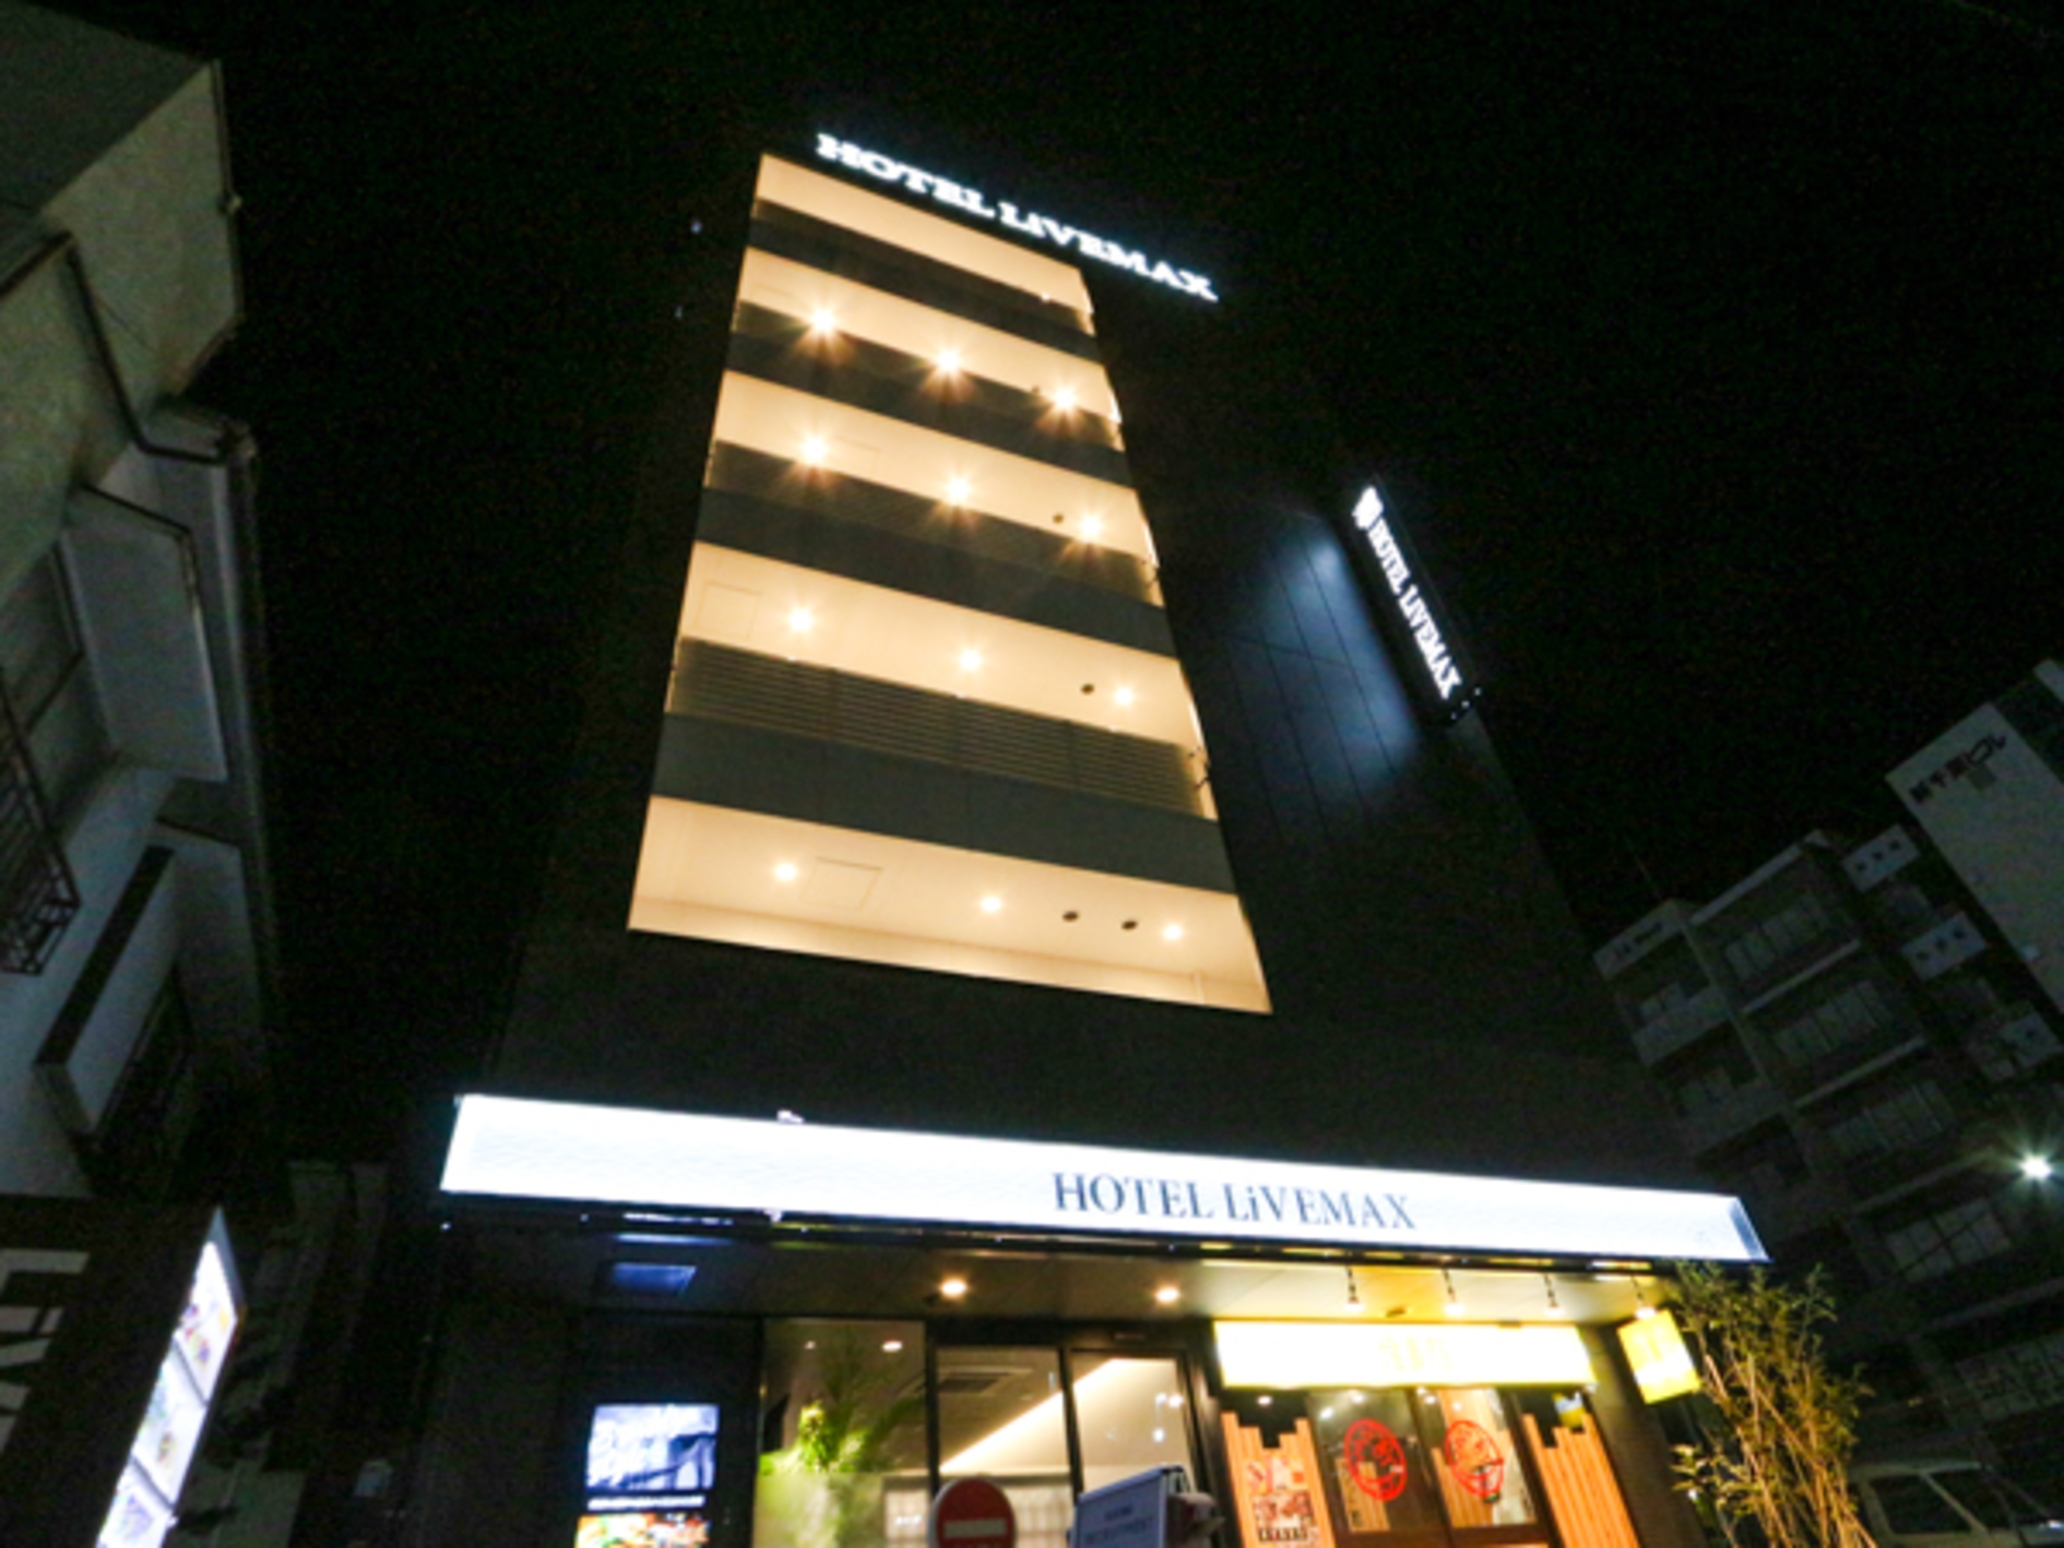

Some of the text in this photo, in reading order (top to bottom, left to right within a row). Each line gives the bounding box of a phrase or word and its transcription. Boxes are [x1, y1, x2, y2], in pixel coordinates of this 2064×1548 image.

[816, 132, 996, 219] HOTEL
[1366, 516, 1411, 597] HOTEL
[1053, 1171, 1213, 1220] HOTEL
